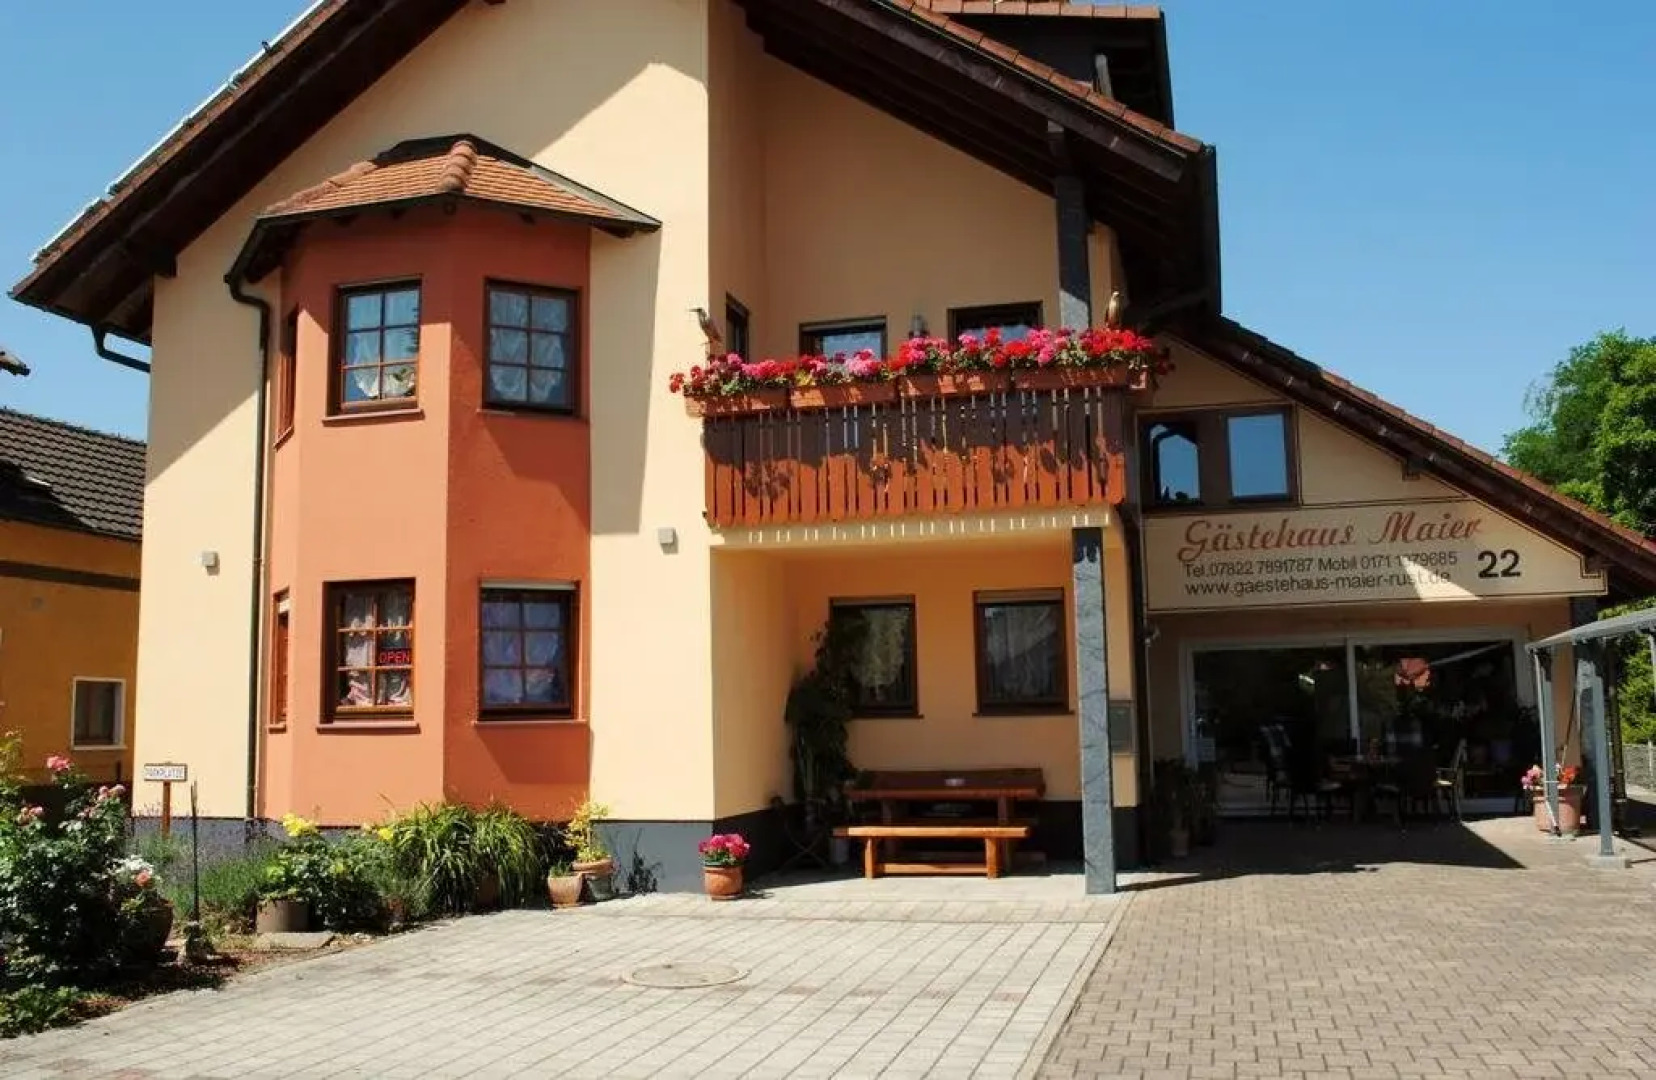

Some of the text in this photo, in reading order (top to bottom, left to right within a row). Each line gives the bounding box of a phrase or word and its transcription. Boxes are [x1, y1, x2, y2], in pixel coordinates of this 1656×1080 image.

[1178, 510, 1482, 562] Gästehaus Maier
[1317, 553, 1358, 572] Mobil
[1477, 549, 1522, 579] 22
[379, 651, 411, 664] OPEN
